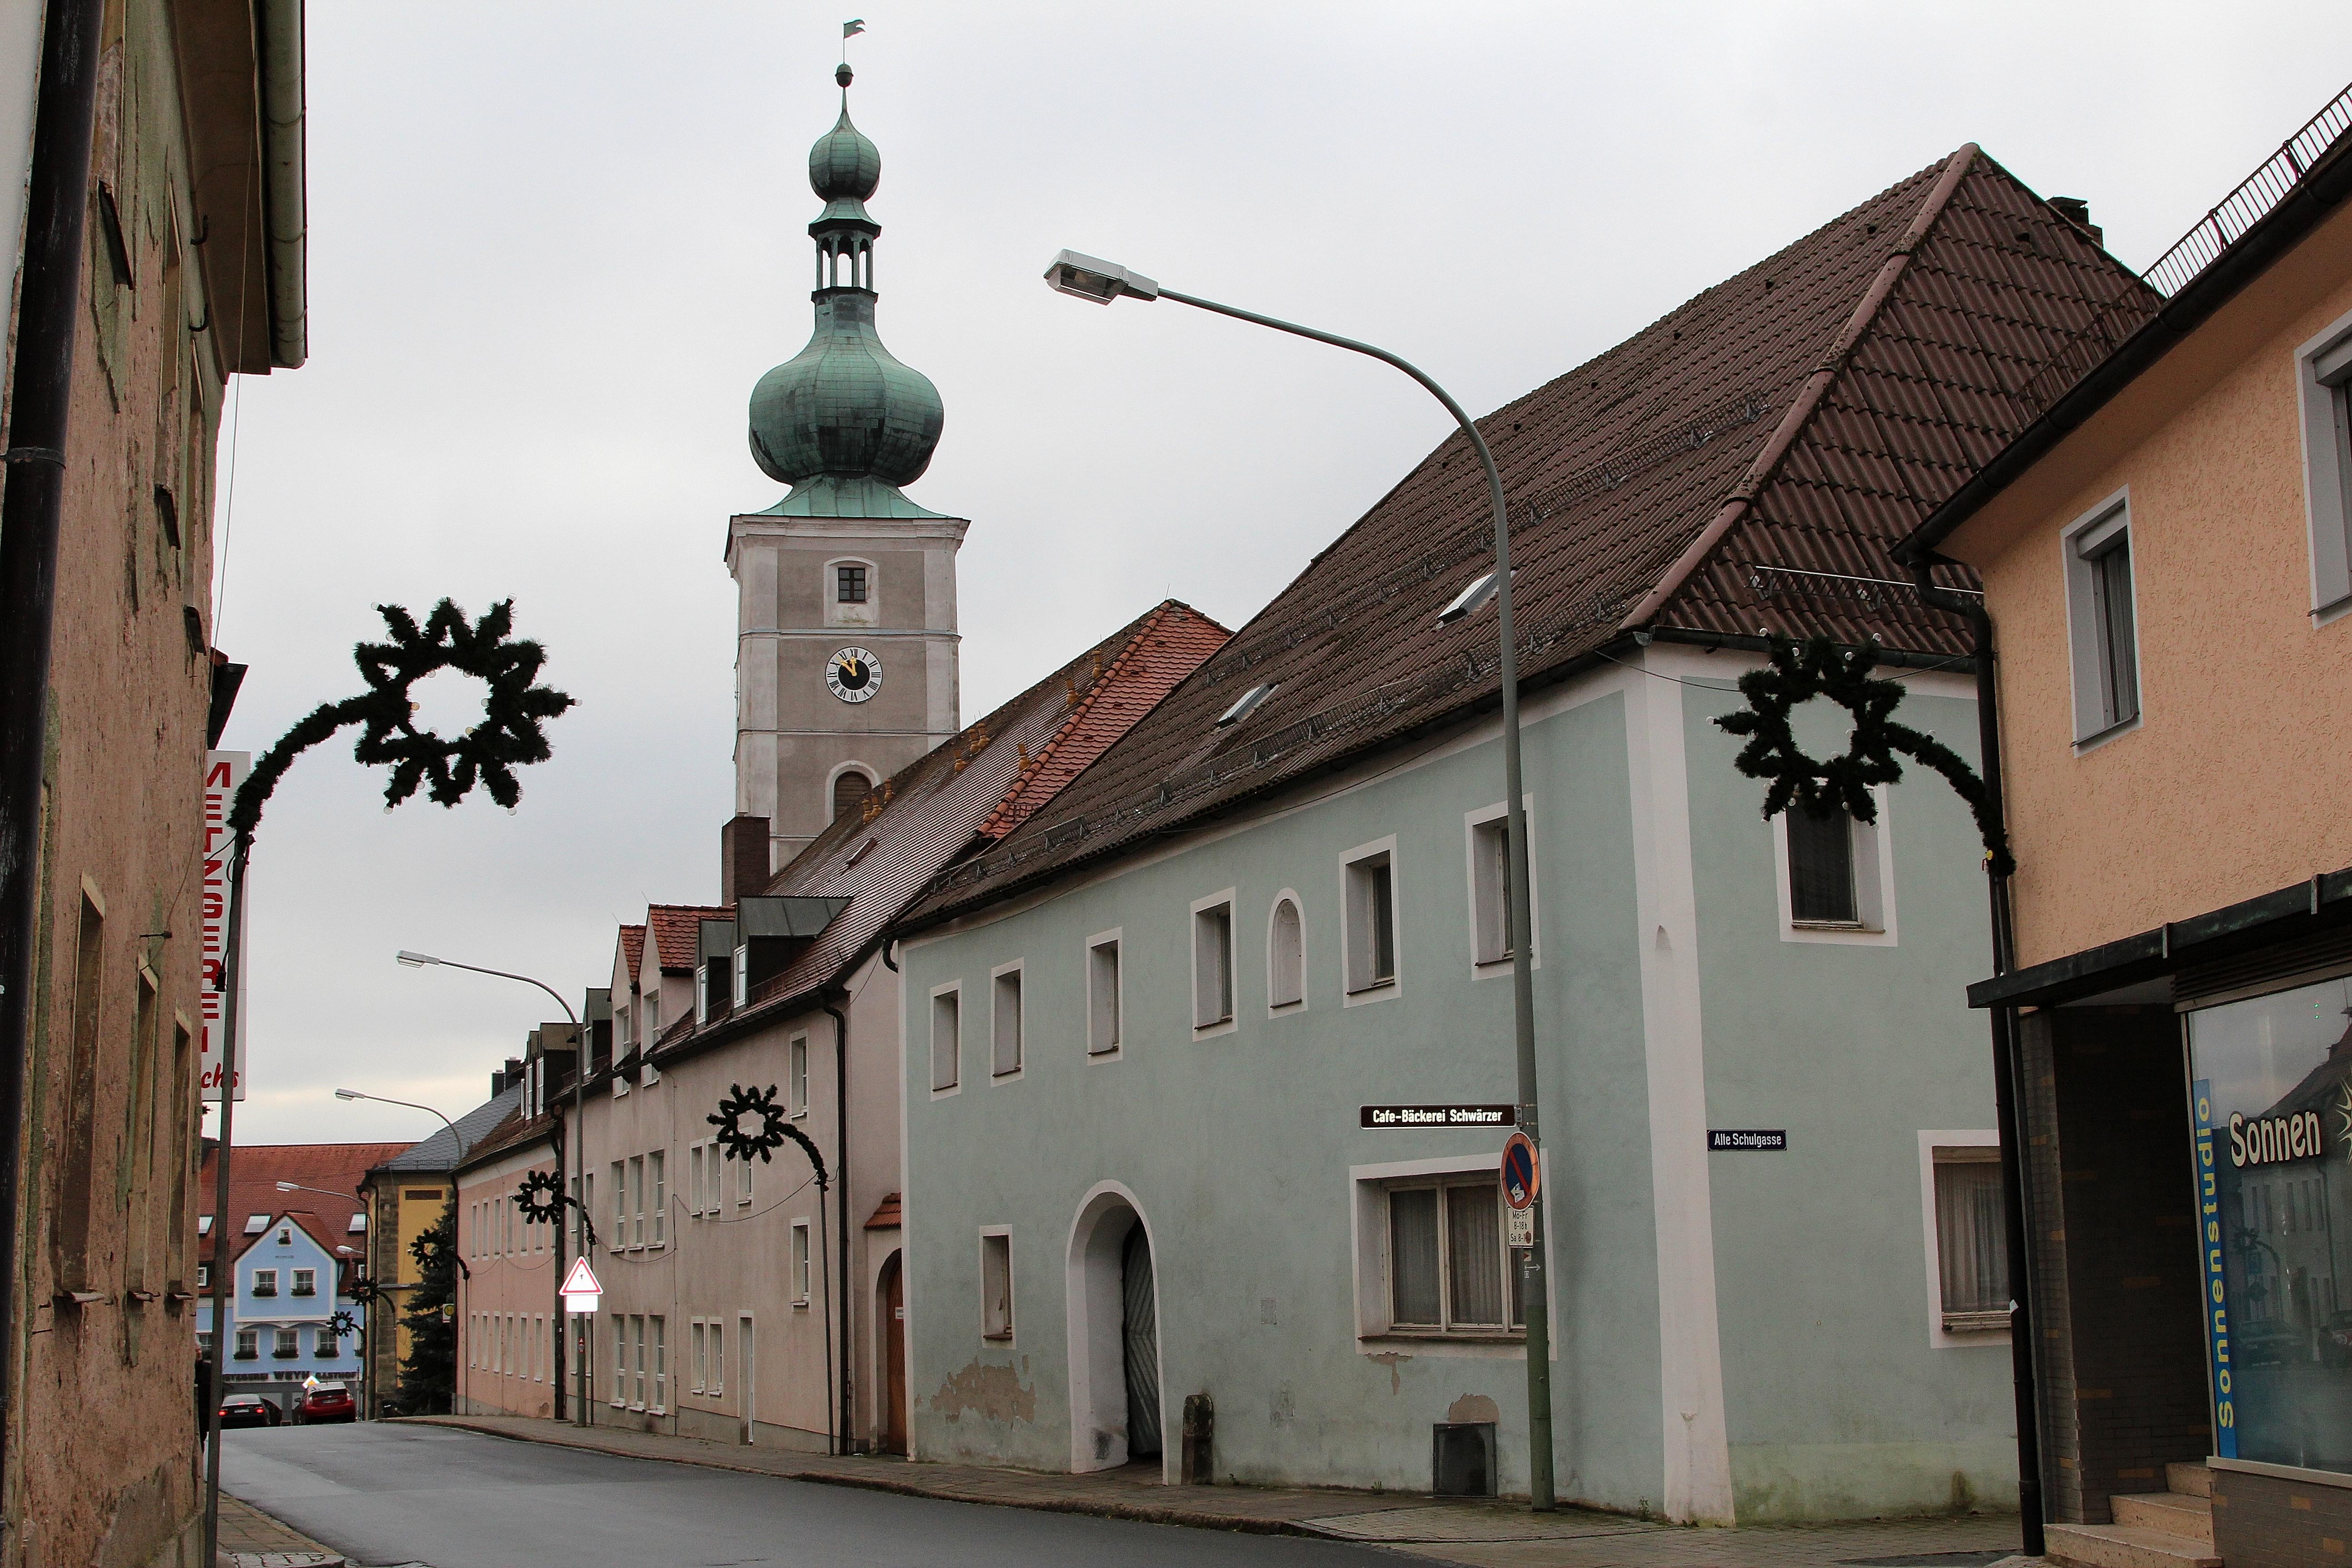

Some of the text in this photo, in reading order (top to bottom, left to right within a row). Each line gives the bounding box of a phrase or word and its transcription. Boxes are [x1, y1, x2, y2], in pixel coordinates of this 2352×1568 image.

[862, 652, 868, 661] I
[829, 659, 840, 668] X
[868, 660, 878, 668] II
[862, 689, 870, 699] V
[1372, 1108, 1503, 1123] Cafe-Bäckerei Schwärzer
[1714, 1133, 1782, 1148] Alte Schulgasse
[2229, 1111, 2321, 1167] Sonnen
[1512, 1211, 1528, 1219] Mo-Fr
[1514, 1221, 1528, 1230] 8-18h
[1510, 1233, 1516, 1242] Sa
[2196, 1097, 2234, 1429] Sonnenstudio
